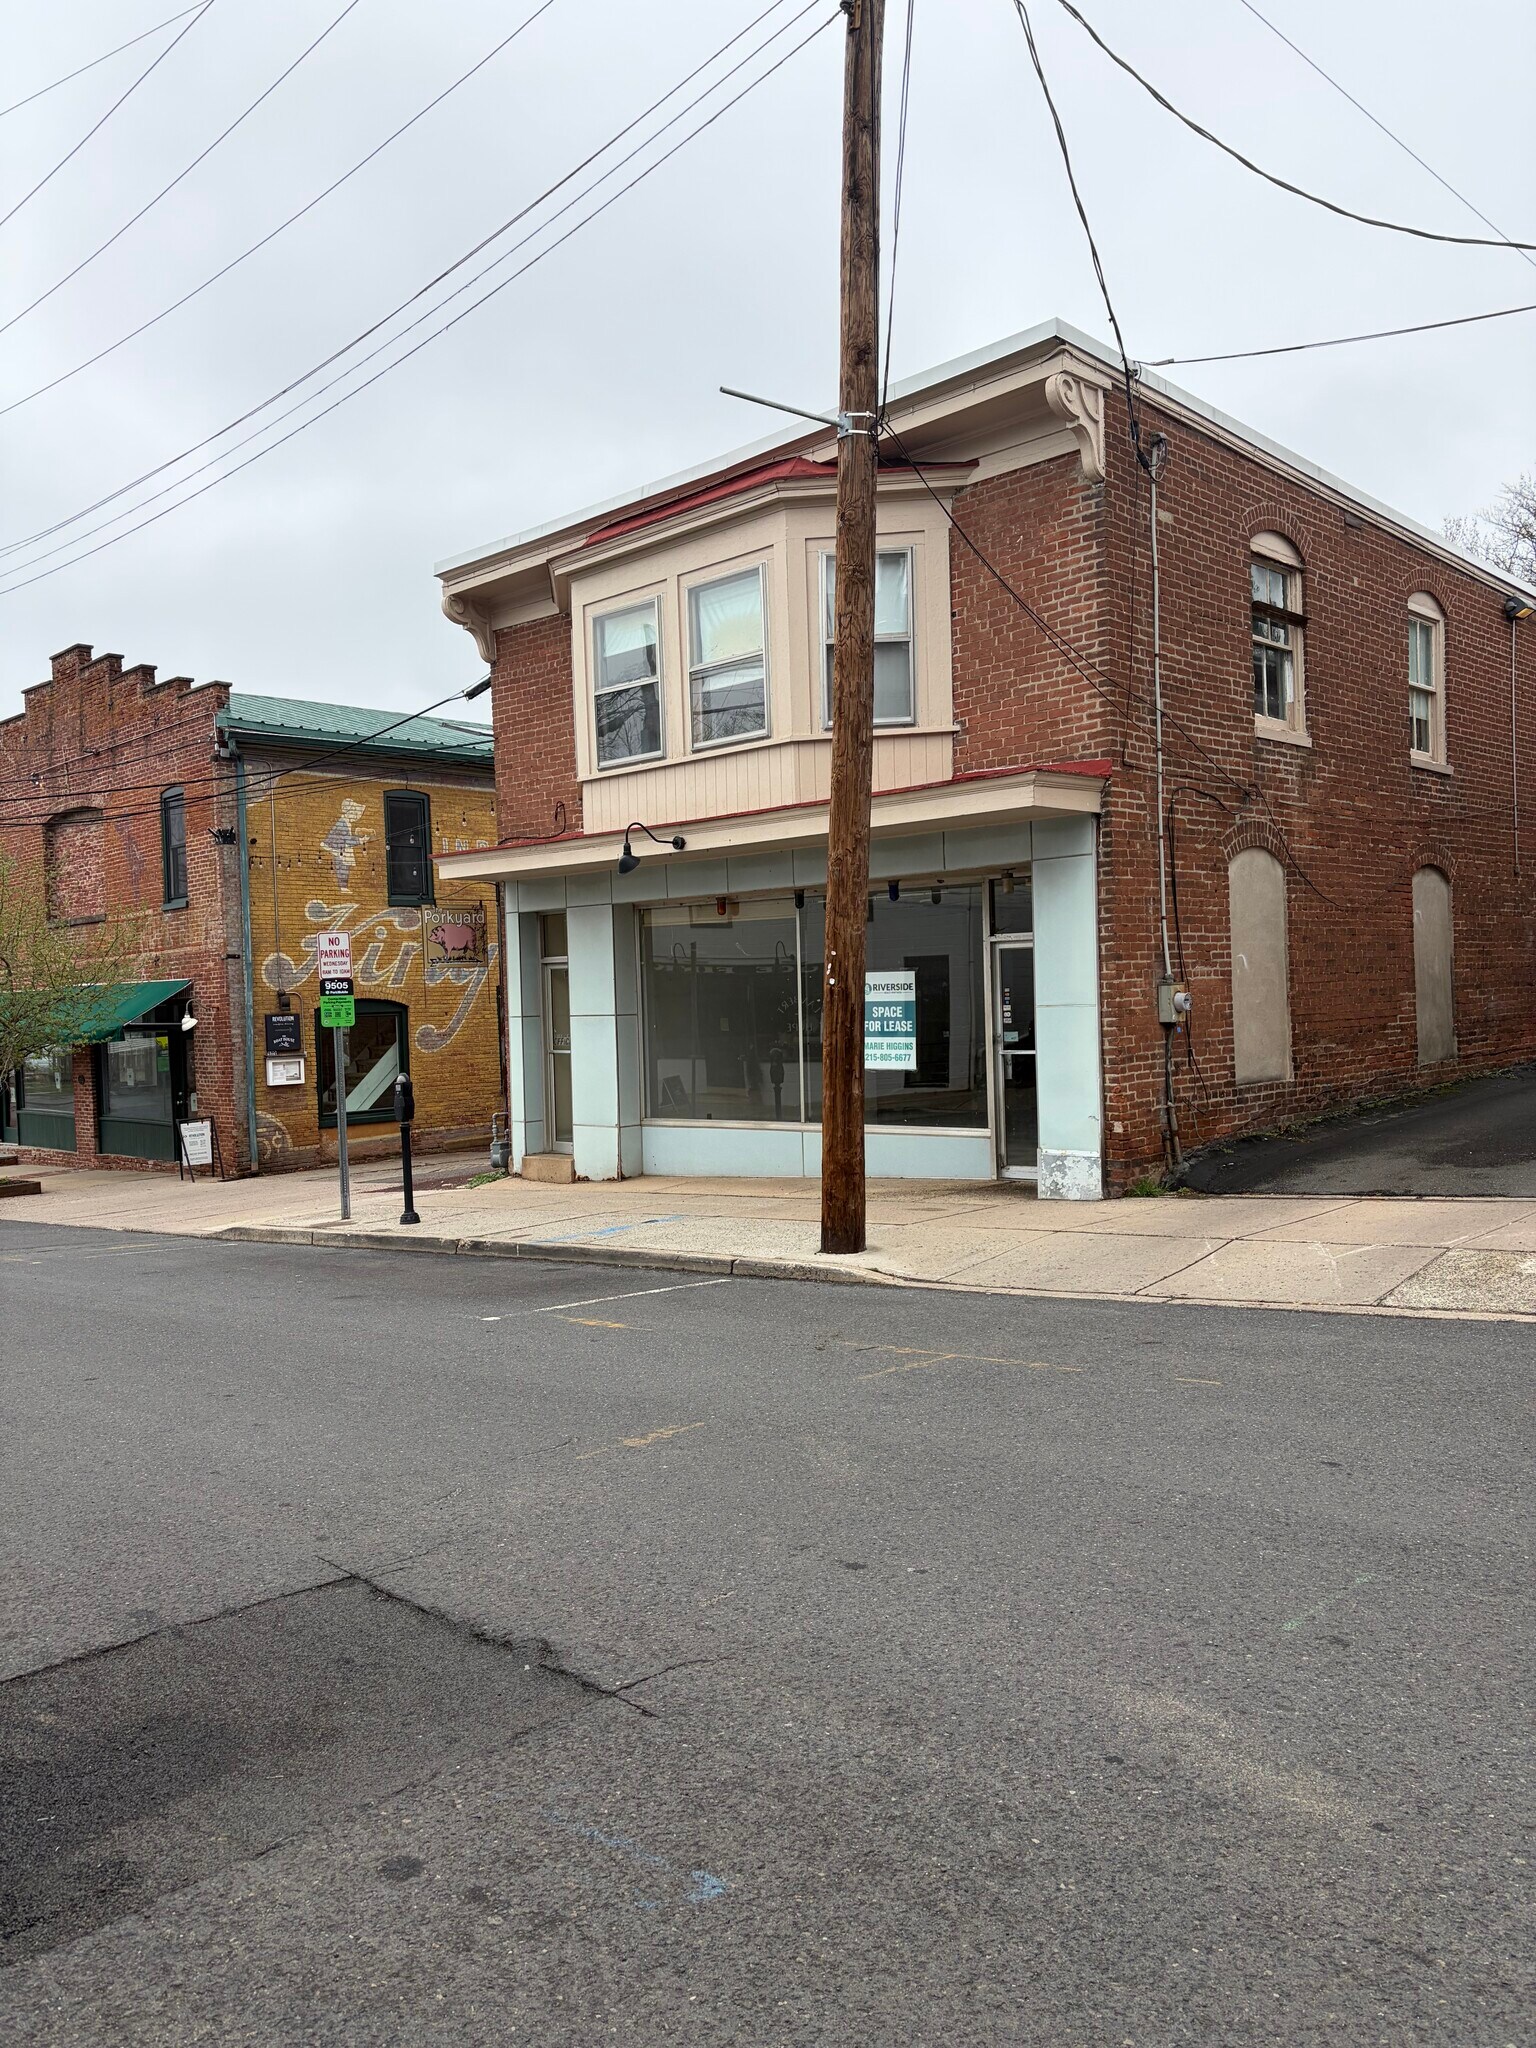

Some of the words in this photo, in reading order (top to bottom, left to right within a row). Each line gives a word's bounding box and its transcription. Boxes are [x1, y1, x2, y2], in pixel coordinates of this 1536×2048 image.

[424, 910, 485, 927] Porkyard
[328, 937, 340, 946] NO
[320, 949, 350, 959] PARKING
[325, 982, 349, 990] 9505
[872, 982, 914, 992] RIVERSIDE
[872, 1006, 903, 1018] SPACE
[864, 1021, 881, 1032] FOR
[884, 1020, 913, 1032] LEASE
[865, 1042, 884, 1051] MARIE
[886, 1042, 913, 1050] HIGGINS
[865, 1053, 911, 1062] 215-805-6677
